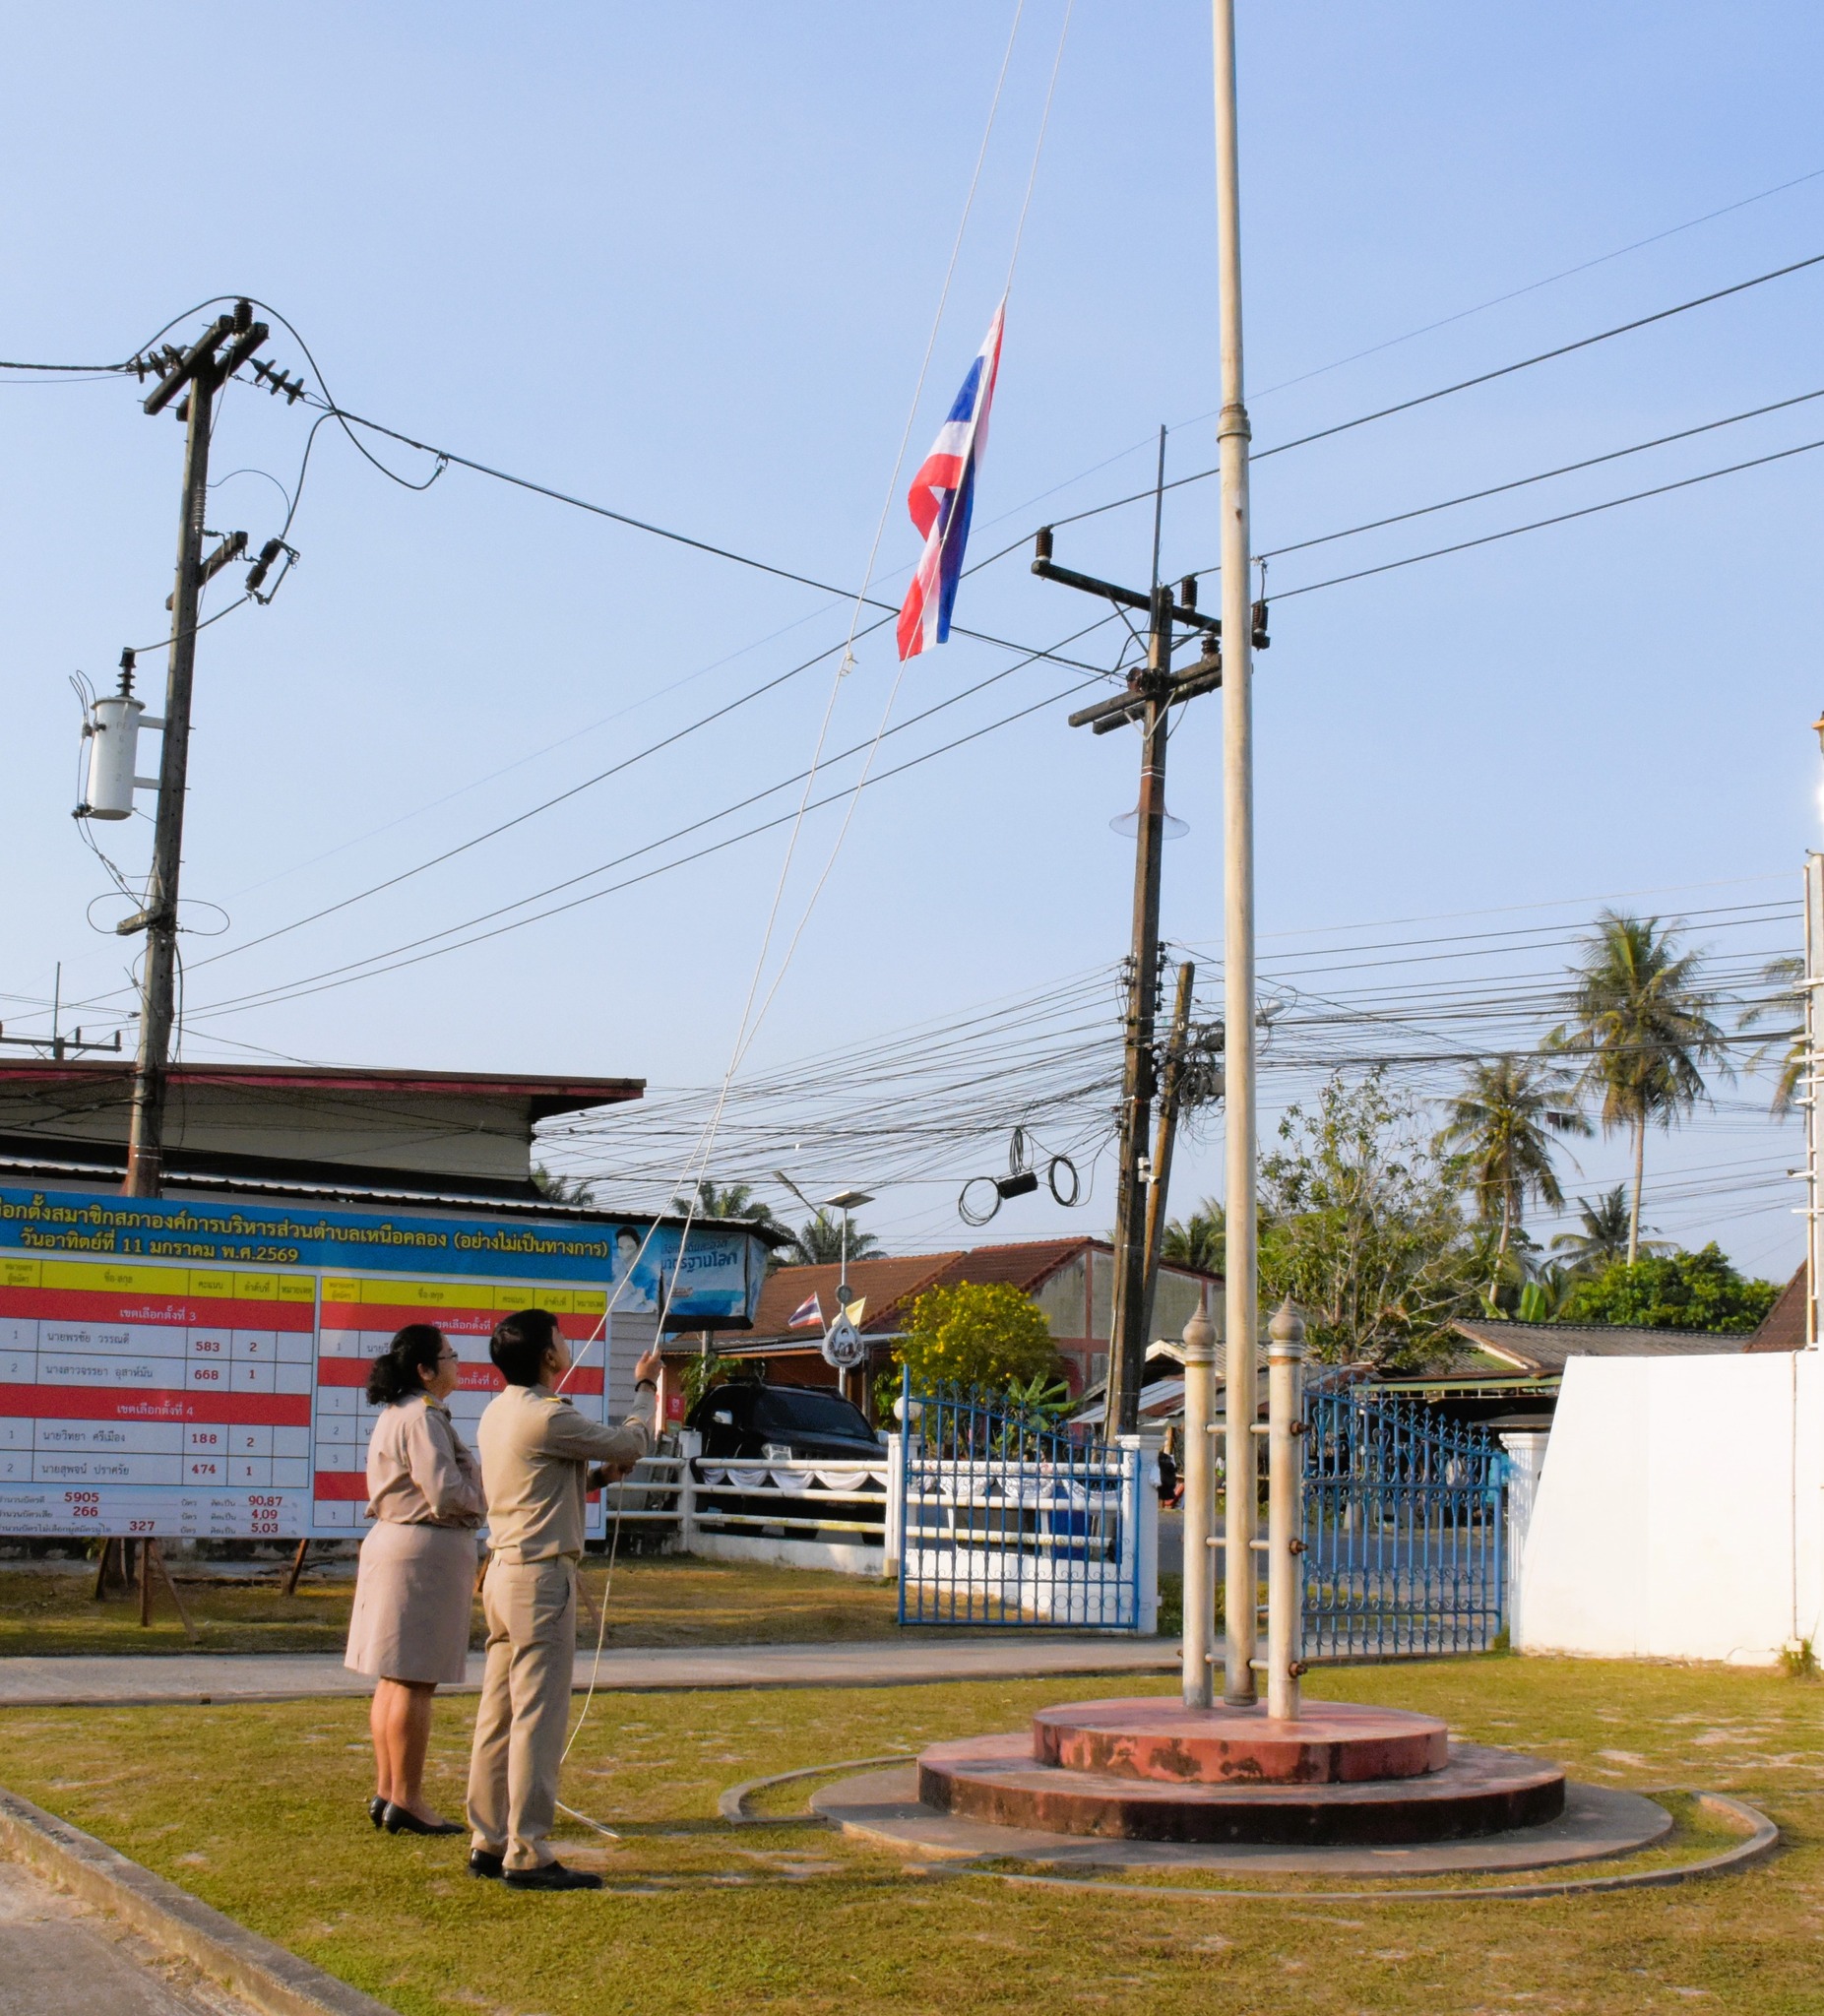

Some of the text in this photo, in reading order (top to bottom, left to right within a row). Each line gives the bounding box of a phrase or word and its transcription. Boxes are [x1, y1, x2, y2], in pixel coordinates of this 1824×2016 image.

[21, 1227, 299, 1263] วันอาทิตย์ที่ 11 มกราคม พ.ศ.2569
[454, 1229, 608, 1259] (อย่างไม่เป็นทางการ)
[119, 1305, 197, 1321] เขตเลือกตั้งที่ 3
[13, 1330, 18, 1340] 1
[47, 1331, 92, 1344] นายพรชัย
[195, 1341, 220, 1353] 583
[249, 1342, 258, 1353] 2
[337, 1342, 342, 1352] 1
[11, 1362, 18, 1373] 2
[45, 1364, 109, 1376] นางสาวจรรยา
[194, 1369, 220, 1381] 668
[249, 1369, 255, 1379] 1
[492, 1376, 499, 1386] 6
[116, 1400, 194, 1416] เขตเลือกตั้งที่ 4
[335, 1398, 340, 1408] 1
[333, 1425, 340, 1435] 2
[9, 1430, 14, 1439] 1
[43, 1429, 86, 1442] นายวิทยา
[192, 1433, 218, 1444] 188
[246, 1437, 255, 1448] 2
[332, 1454, 339, 1464] 3
[7, 1463, 14, 1473] 2
[191, 1464, 217, 1475] 474
[246, 1466, 252, 1477] 1
[64, 1491, 99, 1503] 5905
[73, 1505, 98, 1517] 266
[332, 1511, 337, 1521] 1
[129, 1521, 155, 1532] 327
